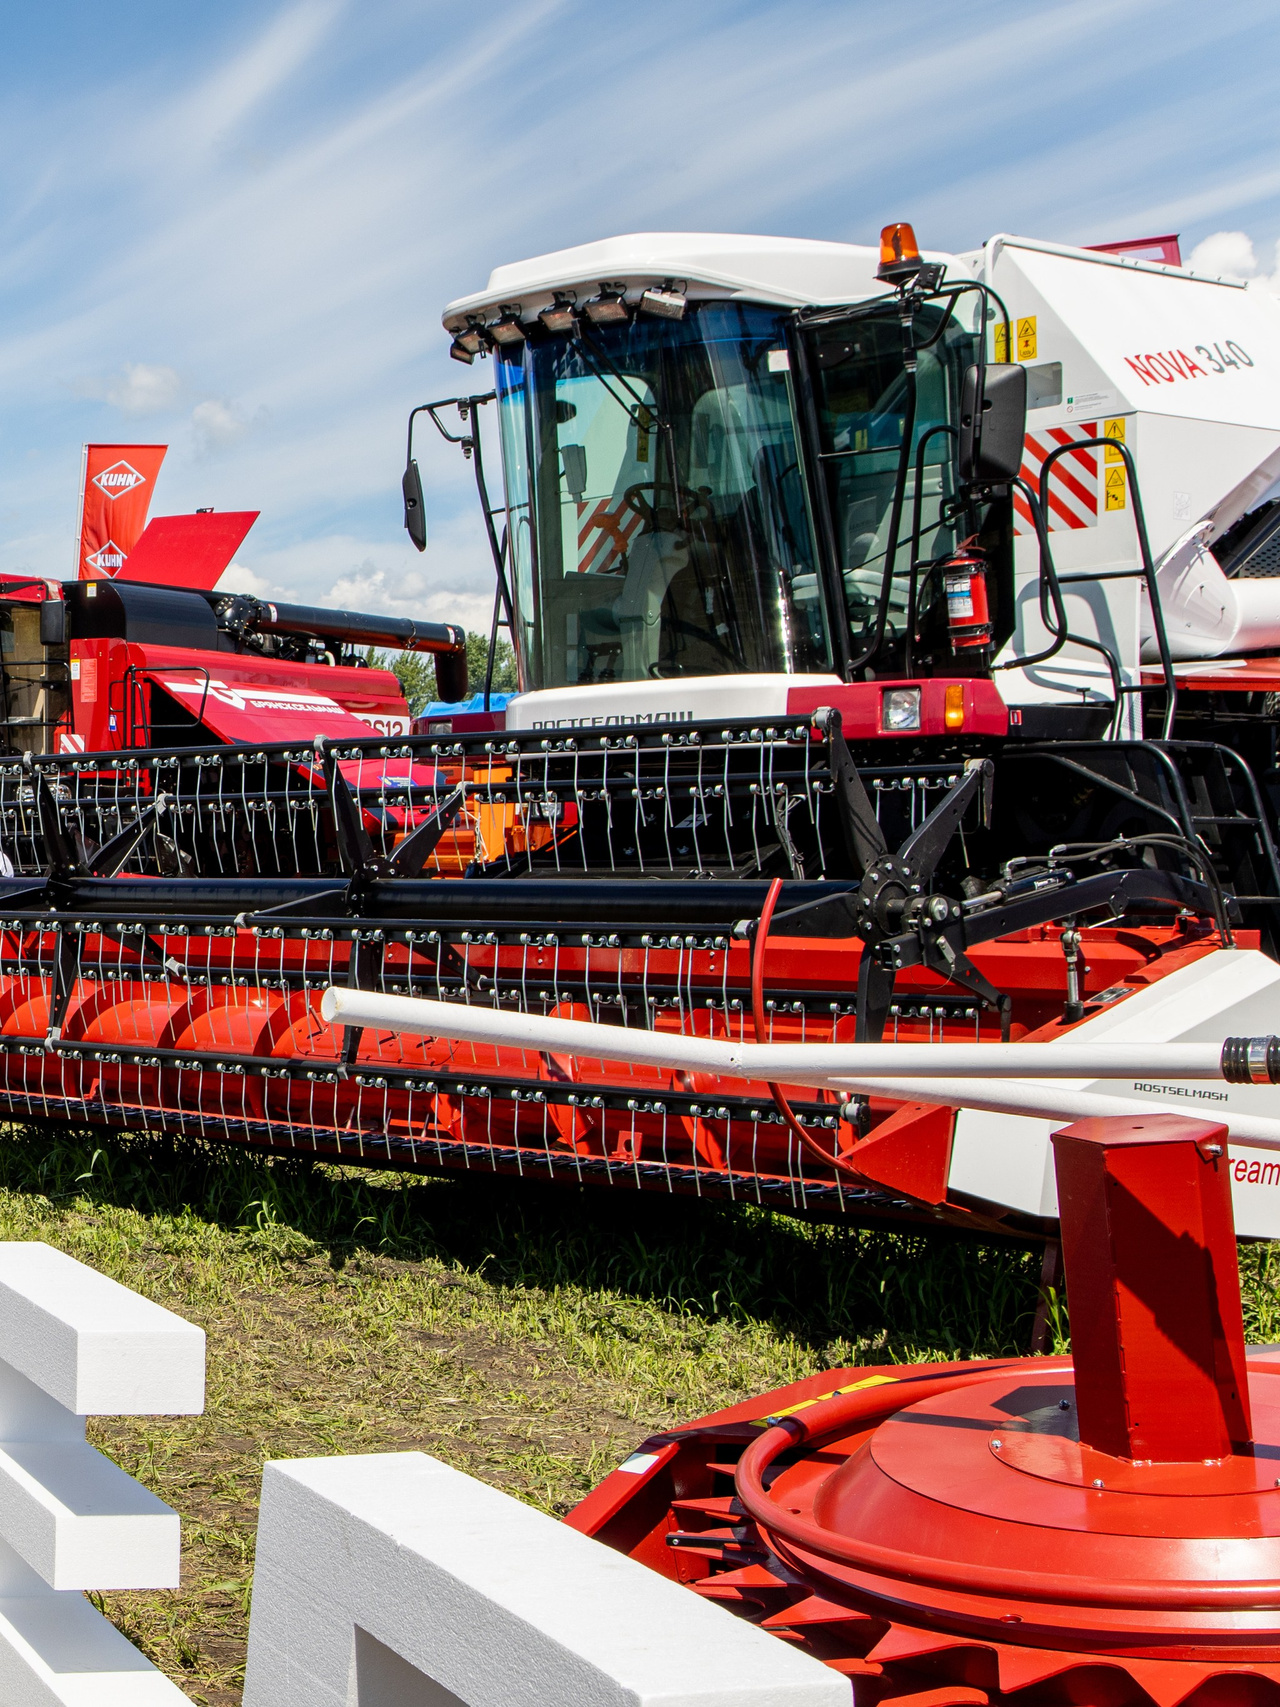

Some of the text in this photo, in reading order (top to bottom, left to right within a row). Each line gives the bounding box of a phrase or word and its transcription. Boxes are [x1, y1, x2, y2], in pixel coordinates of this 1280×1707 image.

[1123, 339, 1255, 386] NOVA 340
[100, 473, 137, 487] KUHN
[96, 553, 123, 567] KUHN
[1133, 1082, 1229, 1102] ROSTSELMASH
